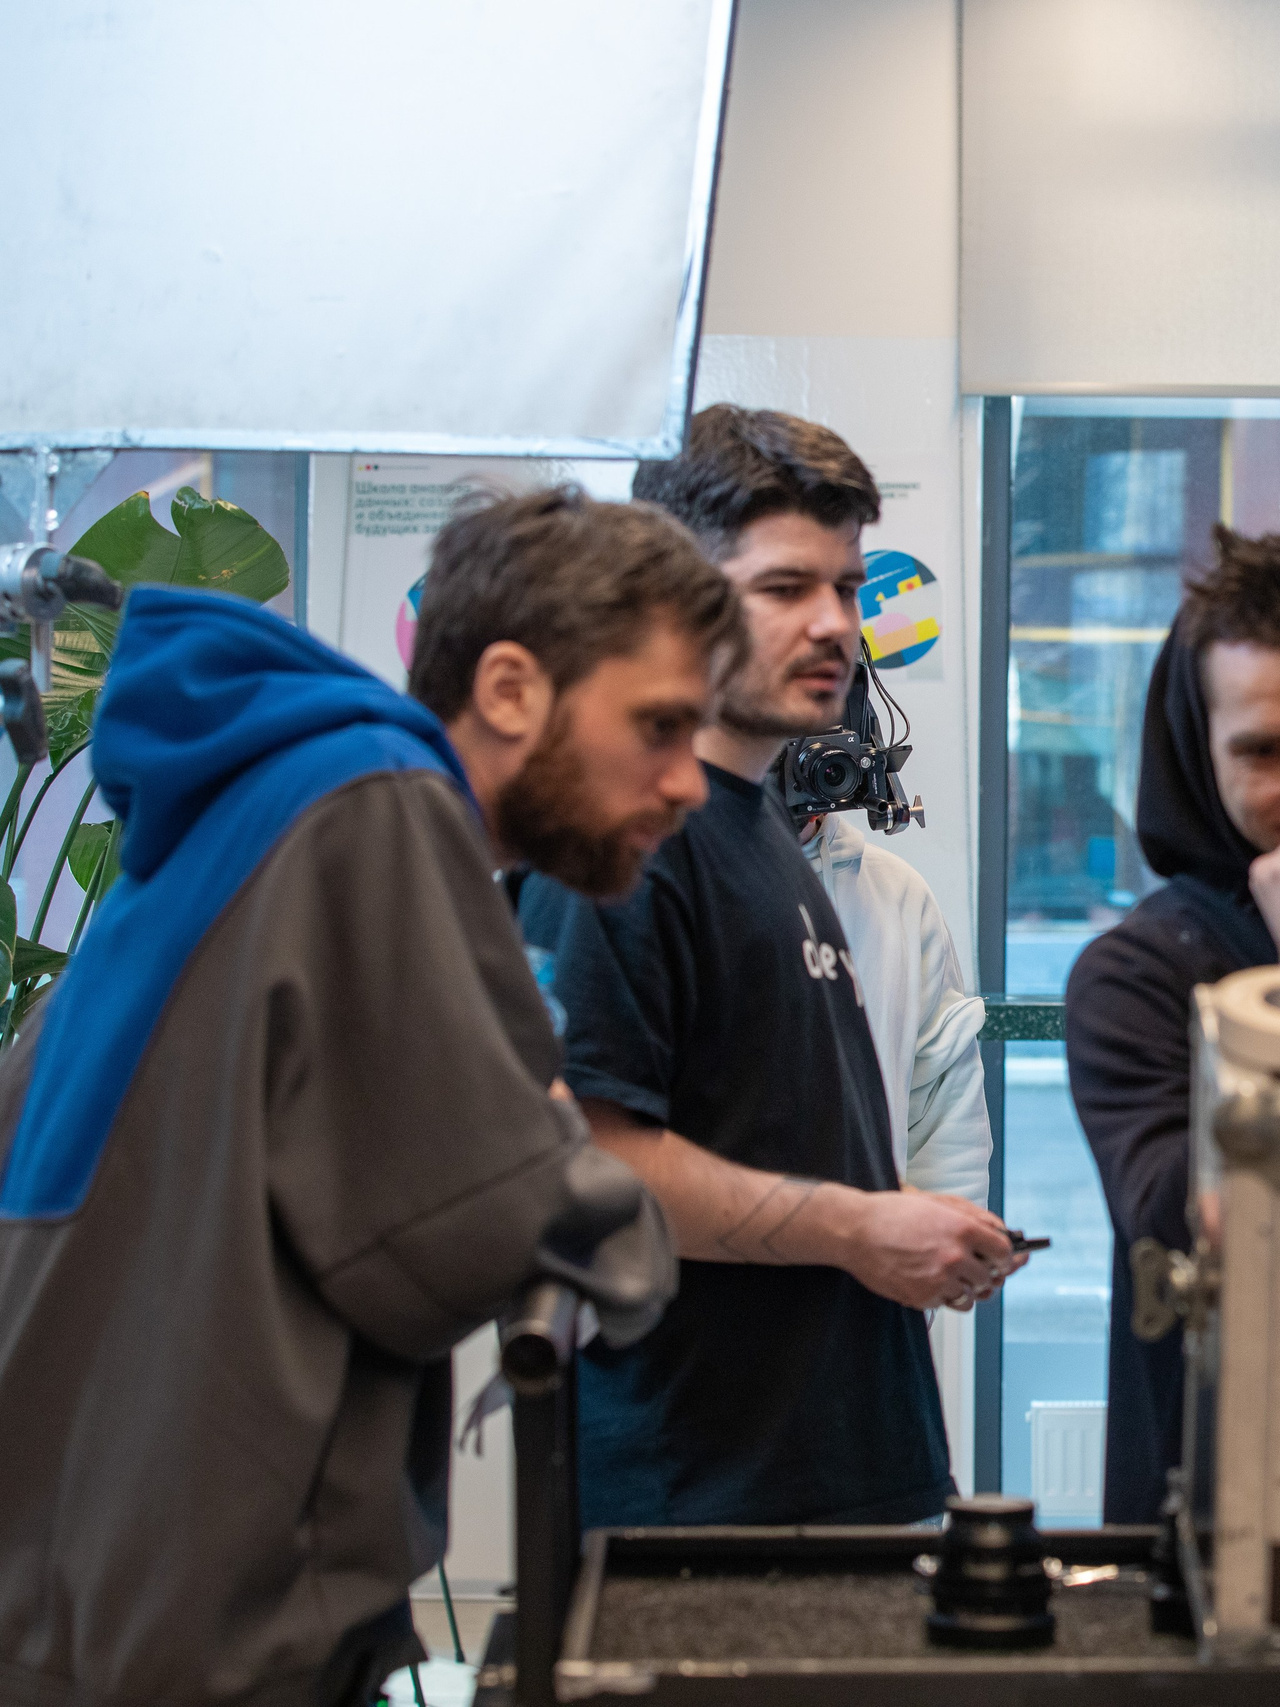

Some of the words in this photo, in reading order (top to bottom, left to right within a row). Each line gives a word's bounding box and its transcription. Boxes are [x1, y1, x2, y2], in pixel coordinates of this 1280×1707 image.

[354, 480, 406, 494] Школа
[355, 512, 364, 520] и
[354, 523, 418, 536] будущих
